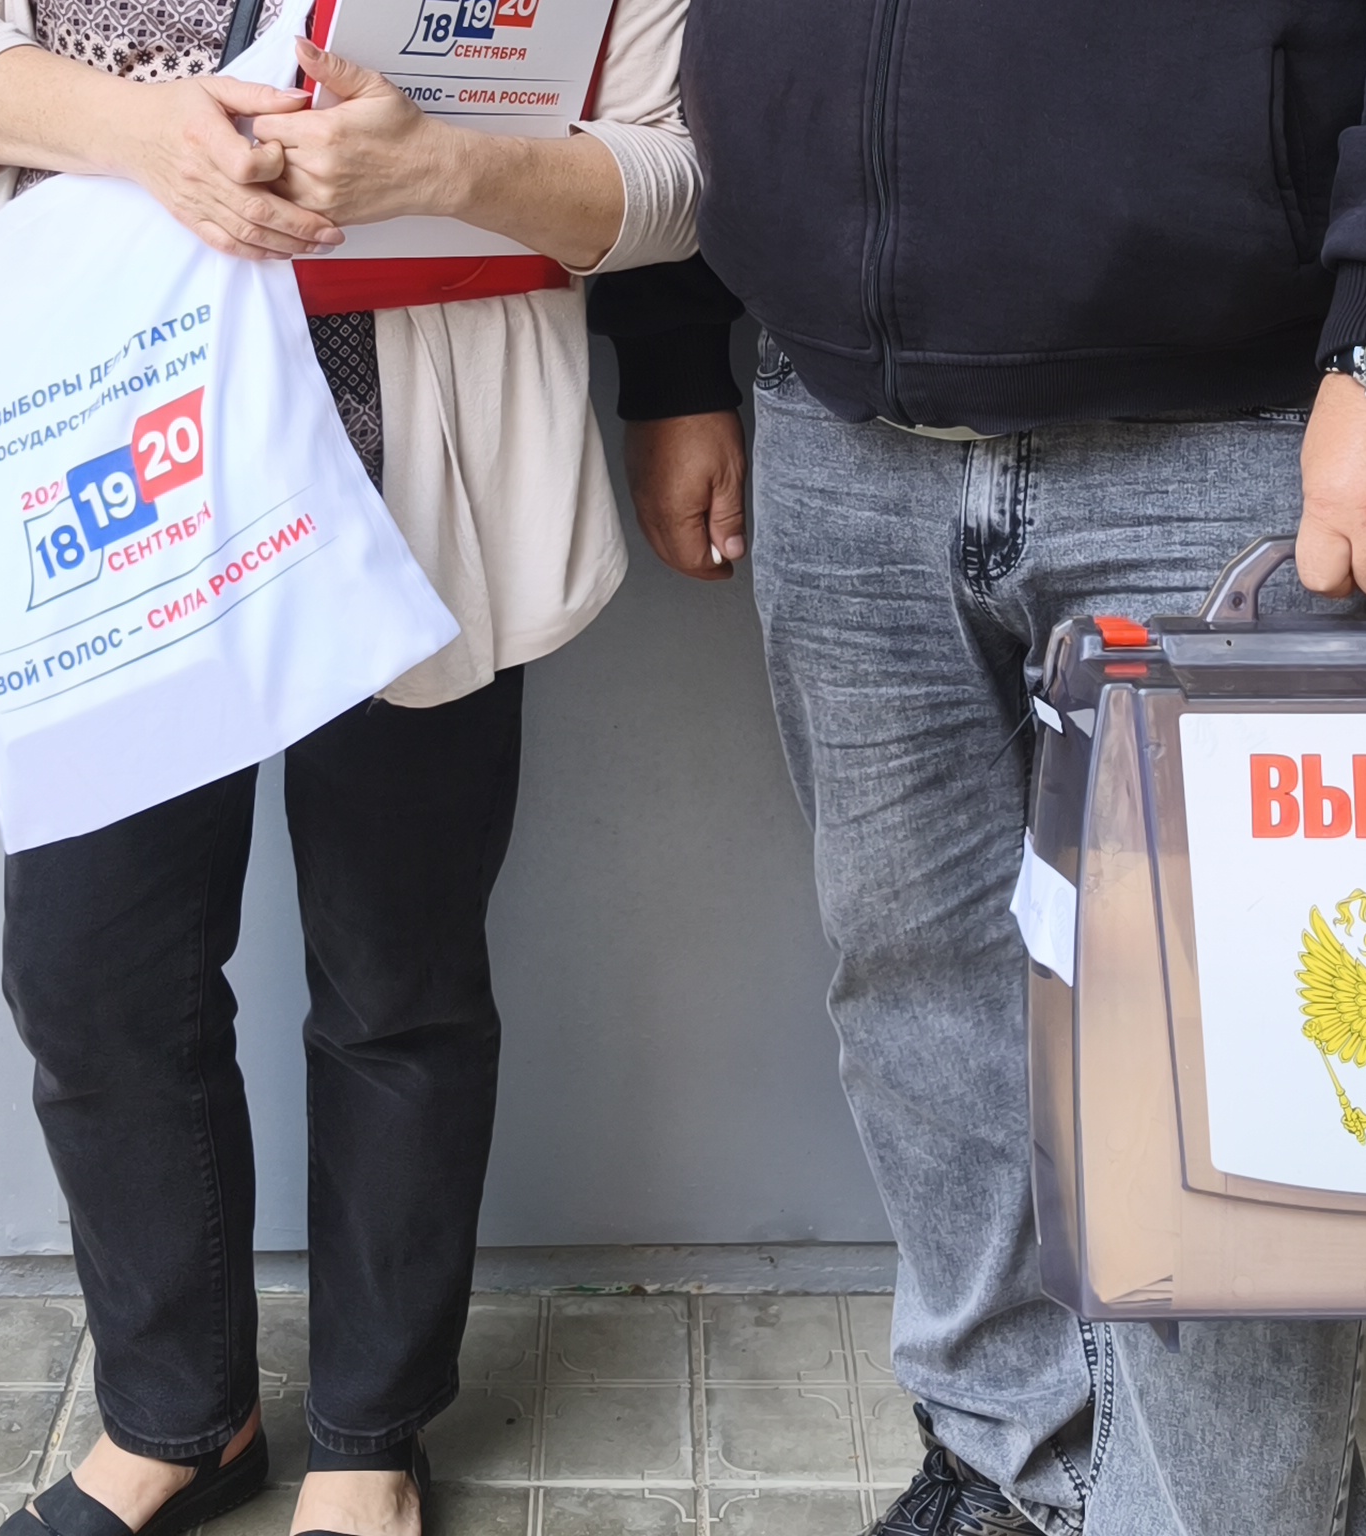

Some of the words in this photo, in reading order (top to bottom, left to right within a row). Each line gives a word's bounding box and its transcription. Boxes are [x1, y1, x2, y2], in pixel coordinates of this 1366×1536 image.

[421, 13, 453, 43] 18
[454, 44, 527, 61] СЕНТЯБРЯ
[398, 86, 443, 102] ОЛОС
[458, 89, 496, 104] СИЛА
[499, 90, 561, 106] РОССИИ!
[165, 342, 209, 382] ДУМ
[20, 477, 65, 511] 202
[36, 525, 85, 580] 18
[79, 471, 137, 529] 19
[138, 416, 200, 482] 20
[43, 628, 123, 678] ГОЛОС
[147, 587, 208, 629] СИЛА
[208, 513, 317, 596] РОССИИ!
